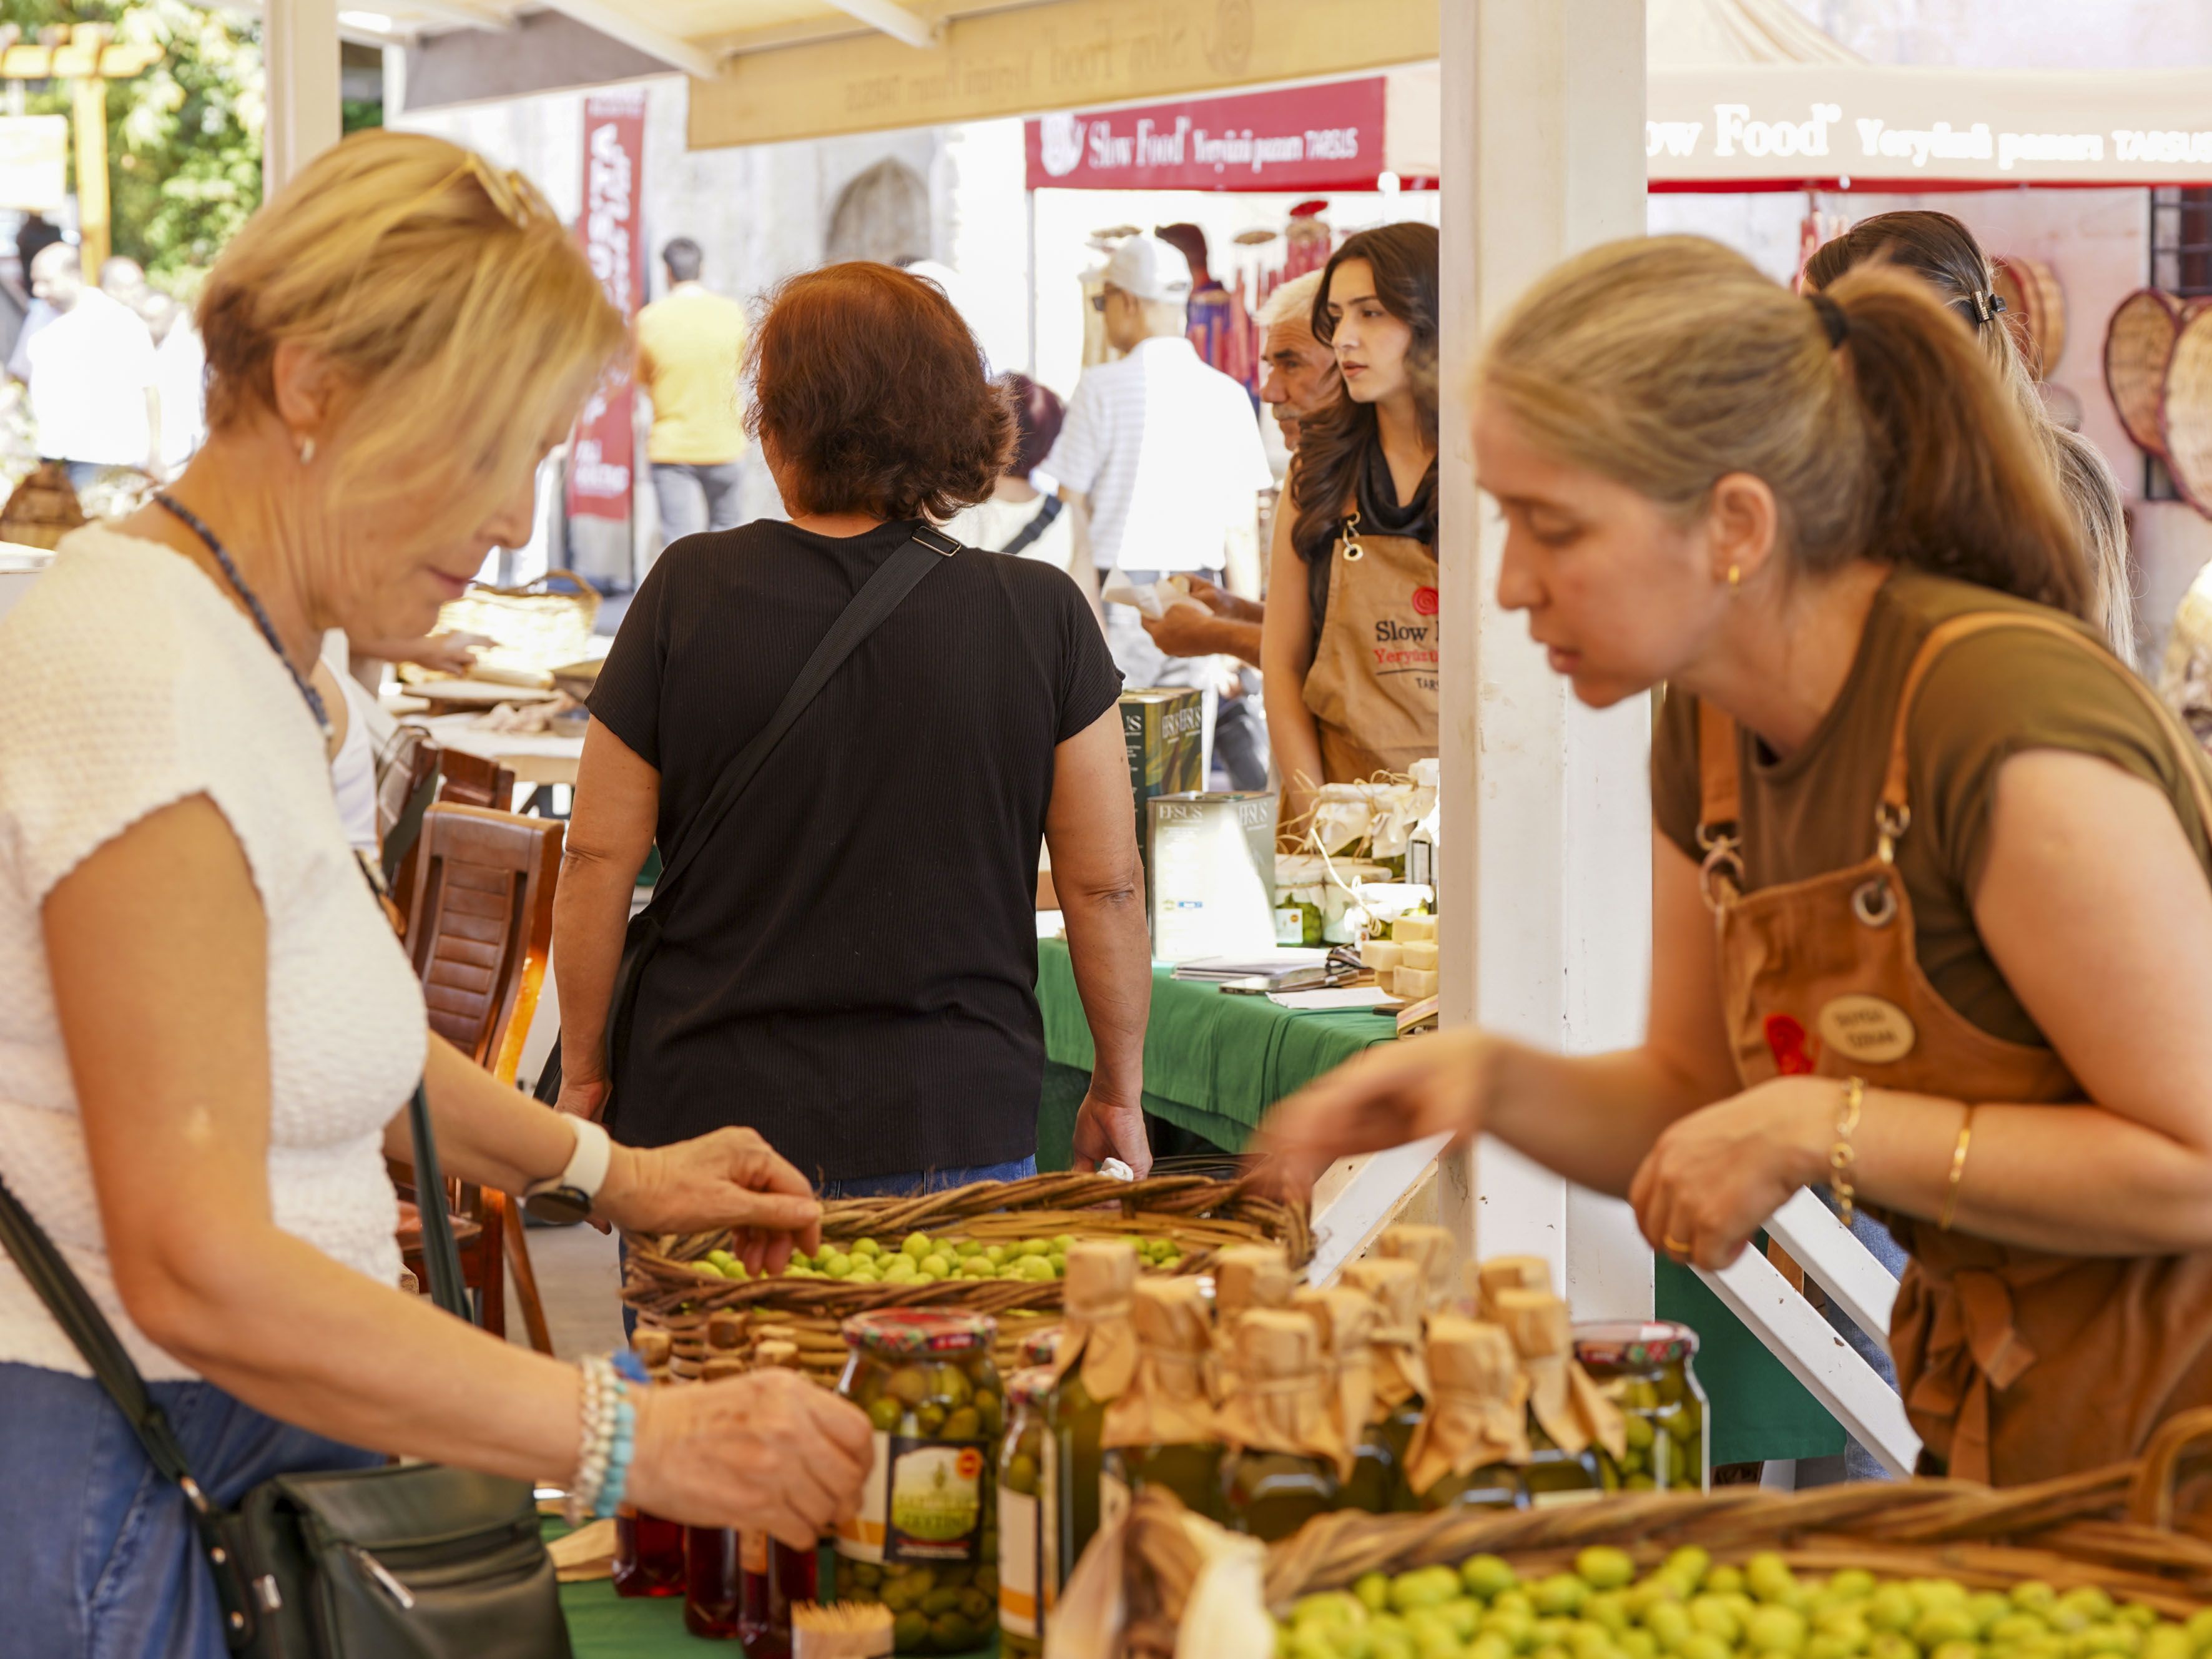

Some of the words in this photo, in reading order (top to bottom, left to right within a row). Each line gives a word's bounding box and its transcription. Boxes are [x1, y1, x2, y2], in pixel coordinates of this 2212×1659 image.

[1646, 121, 1703, 156] ow
[1714, 103, 1830, 156] Food
[1375, 621, 1428, 642] Slow
